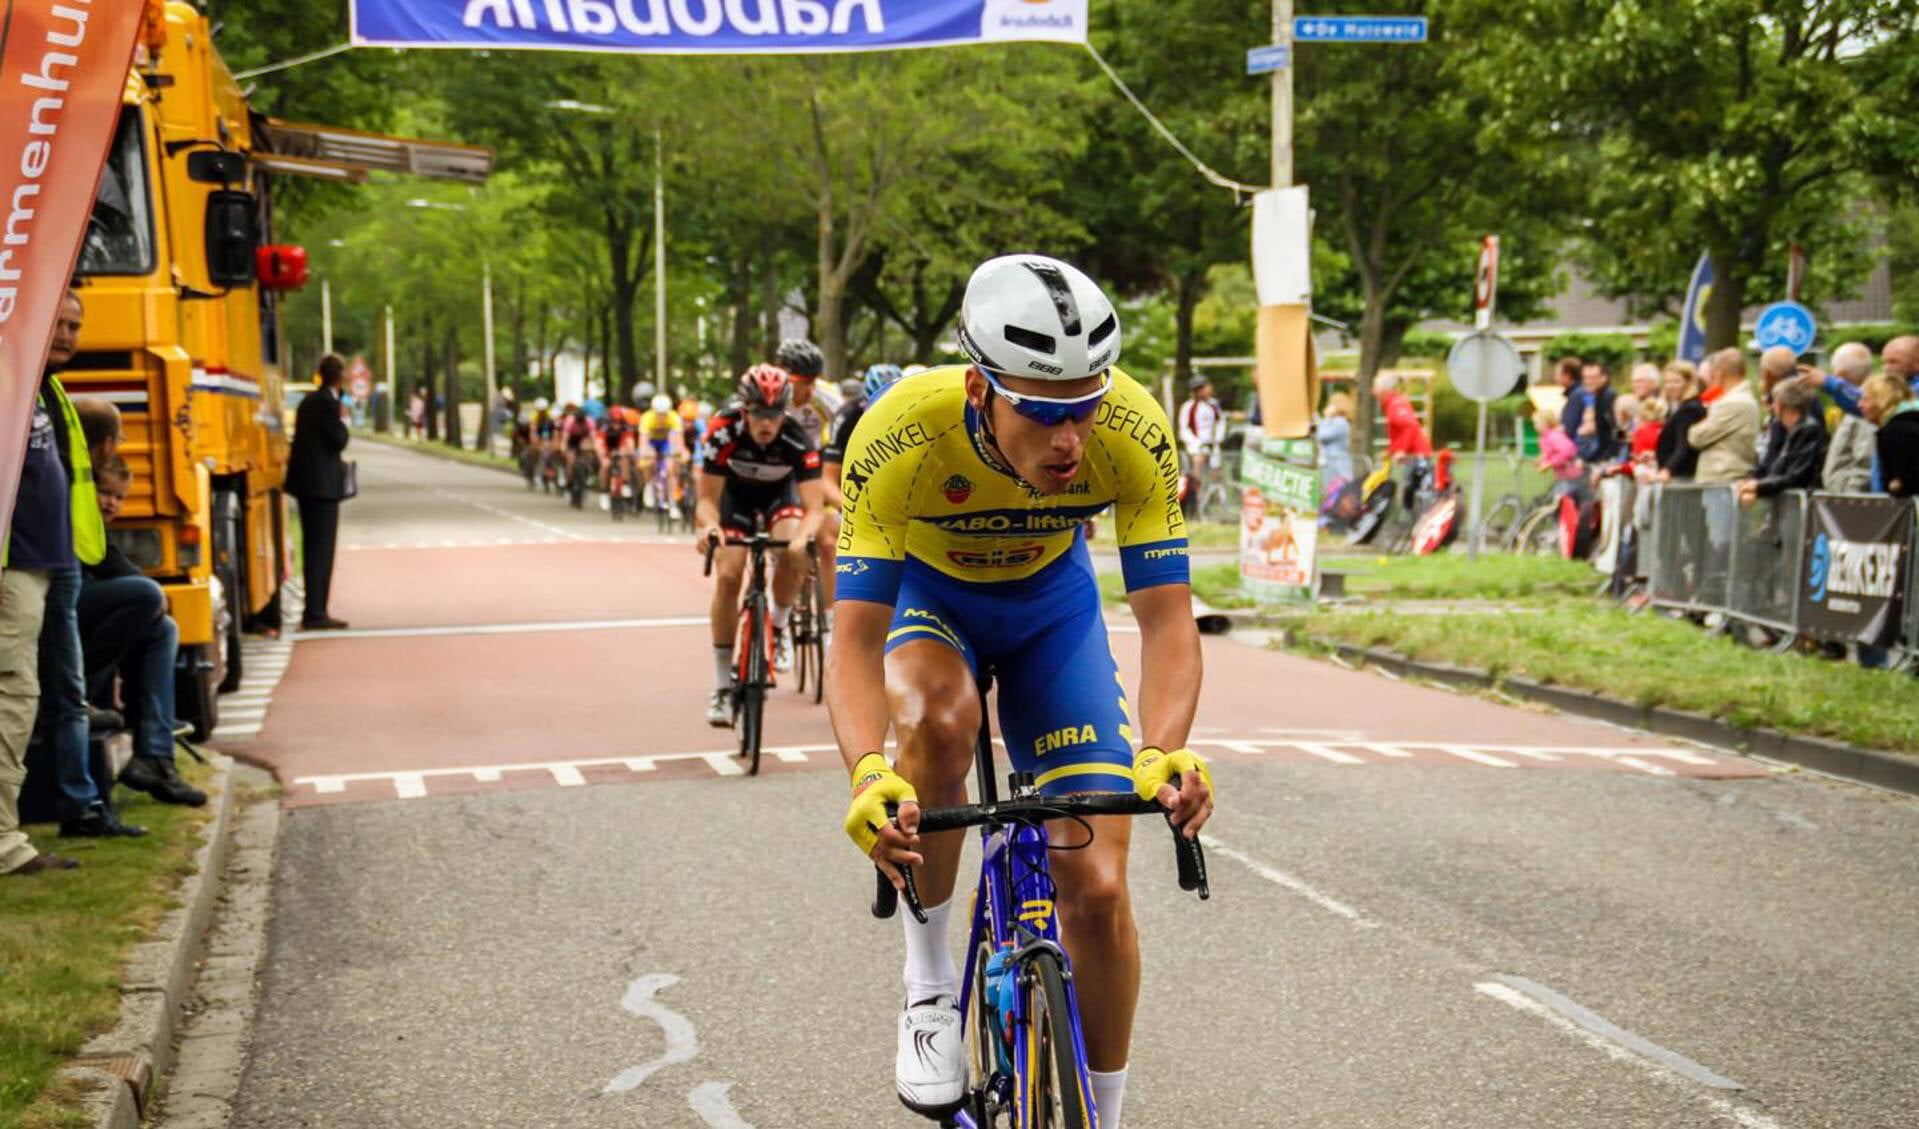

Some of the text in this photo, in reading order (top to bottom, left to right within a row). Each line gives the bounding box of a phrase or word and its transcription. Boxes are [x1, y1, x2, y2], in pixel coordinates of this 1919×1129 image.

[1028, 360, 1064, 376] BBB
[838, 421, 936, 552] DEFLEXWINKEL
[1029, 480, 1091, 501] Rank
[1034, 724, 1098, 757] ENRA
